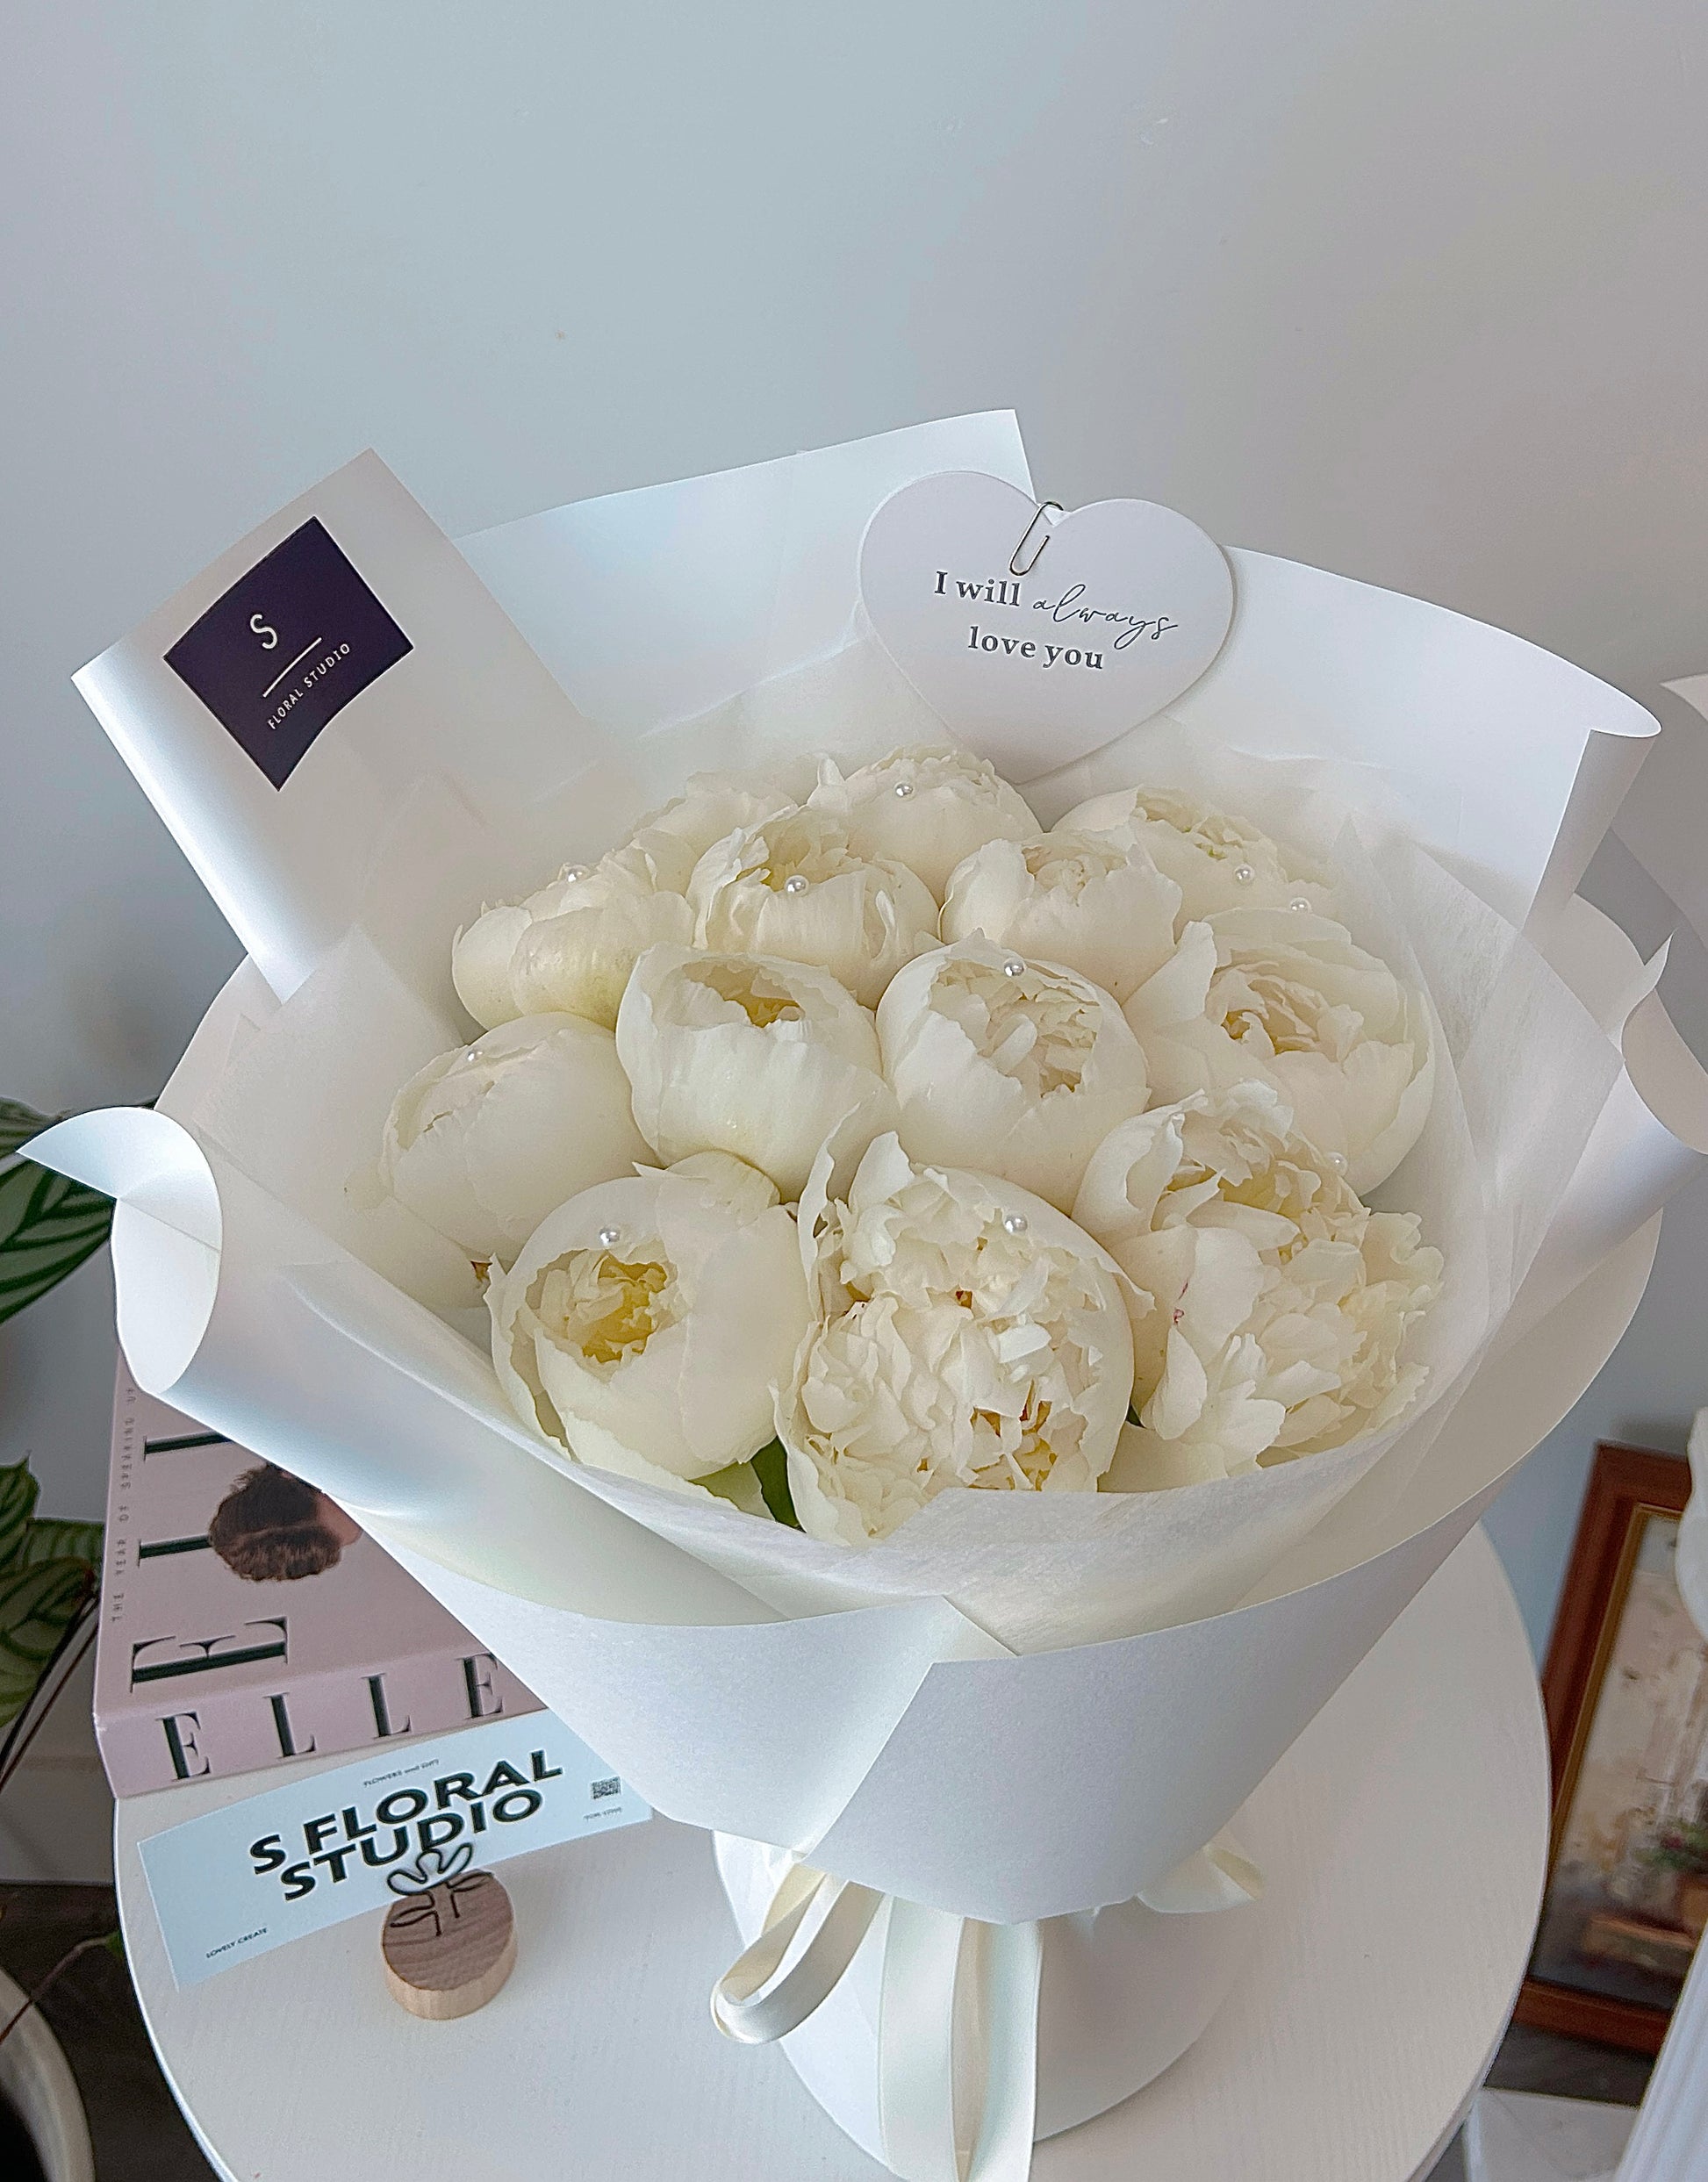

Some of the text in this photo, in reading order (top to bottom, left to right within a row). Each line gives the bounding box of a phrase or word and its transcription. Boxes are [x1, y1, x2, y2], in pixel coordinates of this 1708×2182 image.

[249, 614, 278, 650] S
[935, 571, 1178, 650] I will always
[968, 626, 1104, 669] love you
[267, 642, 351, 729] FLORAL STUDIO
[155, 1652, 505, 1781] ELLE
[249, 1749, 564, 1875] S FLORAL
[280, 1788, 543, 1901] STUDIO
